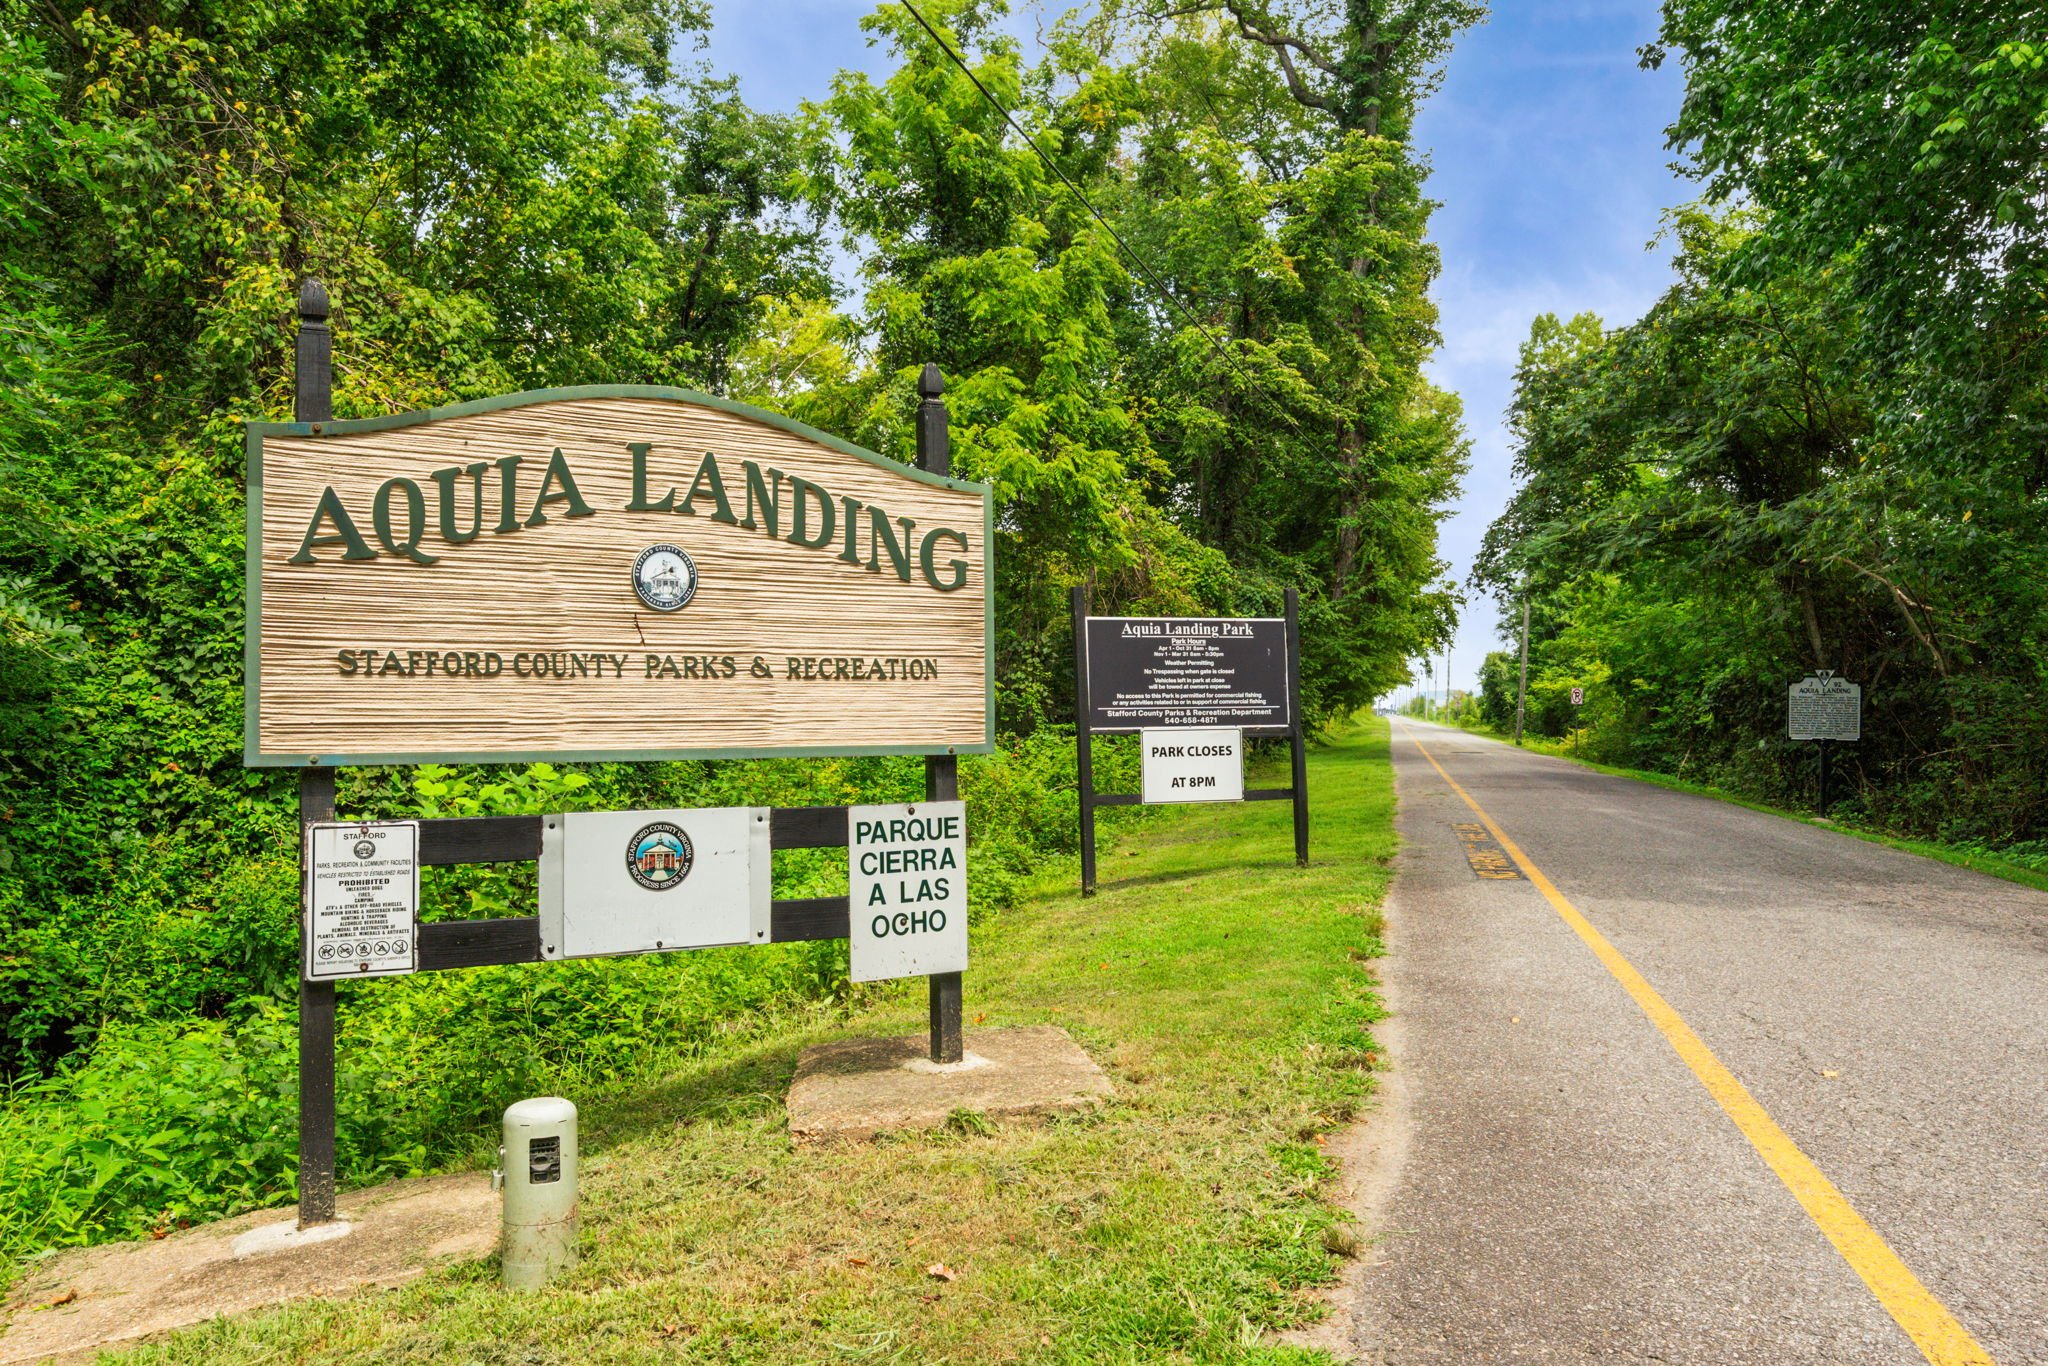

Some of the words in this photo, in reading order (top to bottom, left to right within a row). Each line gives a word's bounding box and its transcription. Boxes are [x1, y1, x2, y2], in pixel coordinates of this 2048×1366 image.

[287, 446, 596, 564] AQUIA
[625, 442, 969, 591] LANDING
[634, 550, 654, 576] STAFFORD
[1121, 622, 1162, 638] Aquia
[1164, 622, 1219, 638] Landing
[1222, 622, 1254, 636] Park
[337, 649, 503, 677] STAFFORD
[513, 652, 628, 678] COUNTY
[644, 654, 737, 679] PARKS
[750, 655, 774, 679] &
[786, 656, 938, 680] RECREATION
[1152, 746, 1184, 757] PARK
[1187, 745, 1232, 757] CLOSES
[1171, 777, 1186, 788] AT
[1189, 777, 1216, 787] 8PM
[343, 832, 386, 840] STAFFORD
[628, 828, 650, 862] STAFFORD
[650, 824, 678, 833] COUNTY
[677, 831, 692, 859] VIRGINIA
[856, 816, 960, 844] PARQUE
[860, 847, 956, 876] CIERRA
[338, 878, 390, 886] PROHIBITED
[630, 864, 659, 889] PROGRESS
[660, 876, 680, 888] SINCE
[868, 882, 887, 906] A
[900, 878, 950, 904] LAS
[872, 910, 946, 938] OCHO
